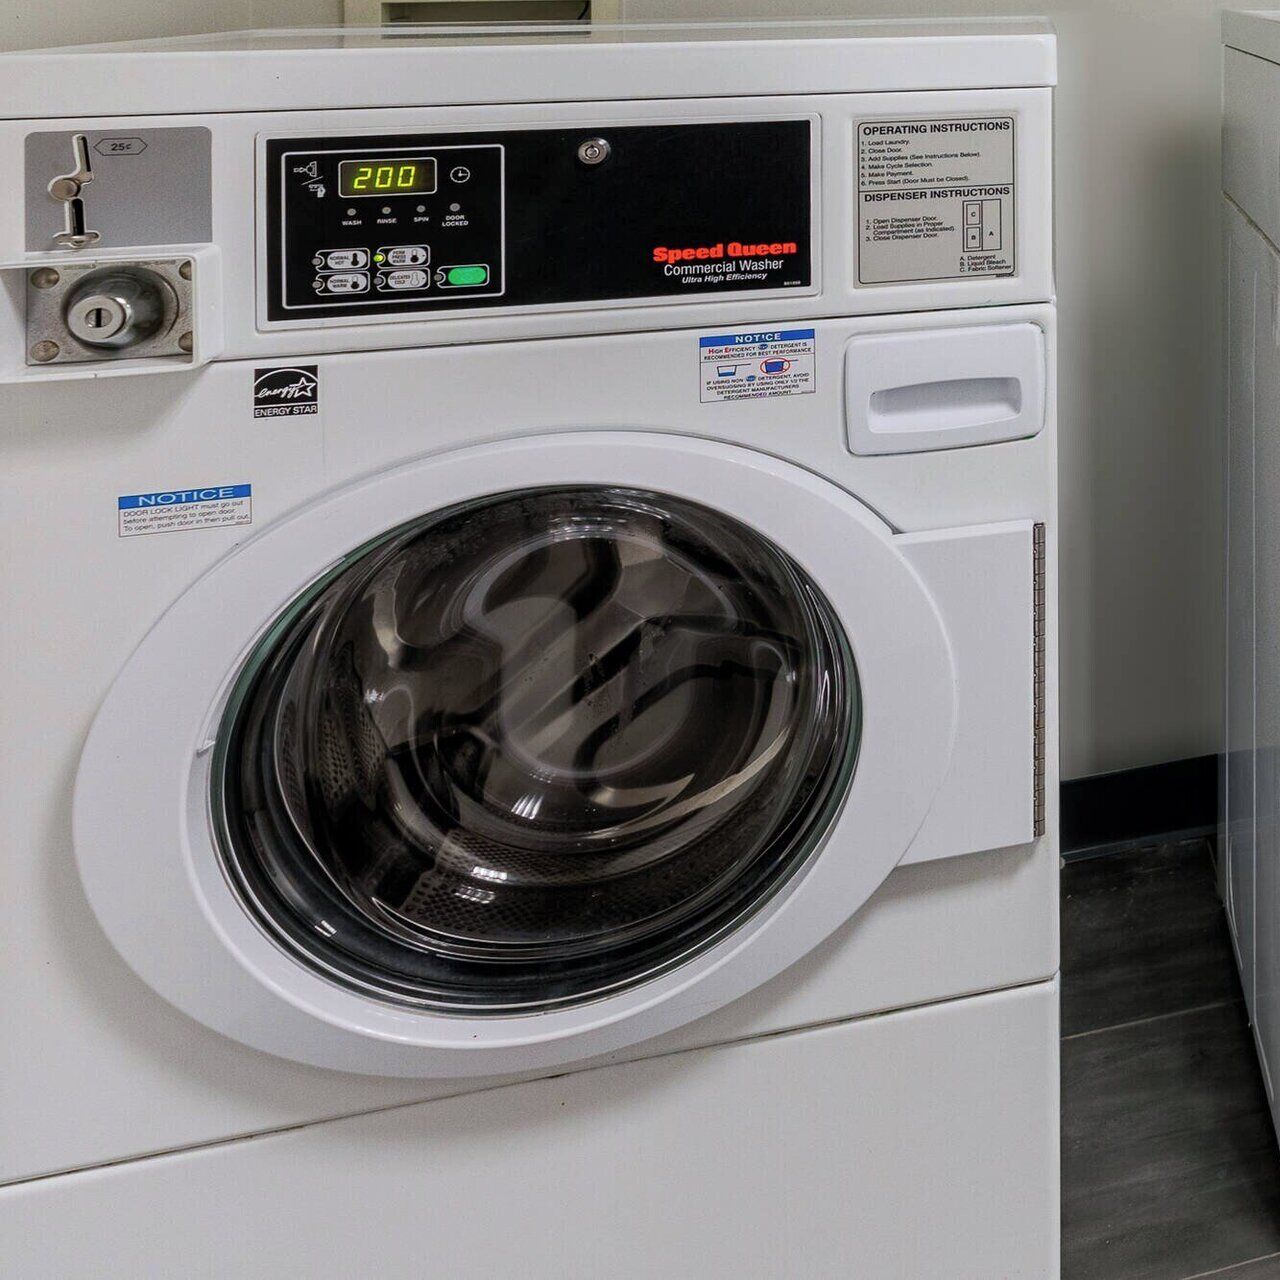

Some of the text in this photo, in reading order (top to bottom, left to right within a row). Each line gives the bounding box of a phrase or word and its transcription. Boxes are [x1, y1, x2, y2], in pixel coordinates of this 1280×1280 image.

[863, 122, 1010, 136] OPERATING INSTRUCTIONS
[354, 167, 415, 188] 200
[864, 187, 1010, 202] DISPENSER INSTRUCTIONS
[653, 241, 797, 263] Speed Queen
[664, 259, 783, 276] Commercial Washer
[682, 272, 767, 284] Ultra High Efficiency
[736, 333, 781, 343] NOTICE
[255, 405, 317, 416] ENERGY STAR
[139, 487, 234, 506] NOTICE
[175, 504, 199, 512] LIGHT
[150, 514, 187, 522] attempting
[157, 521, 175, 529] push
